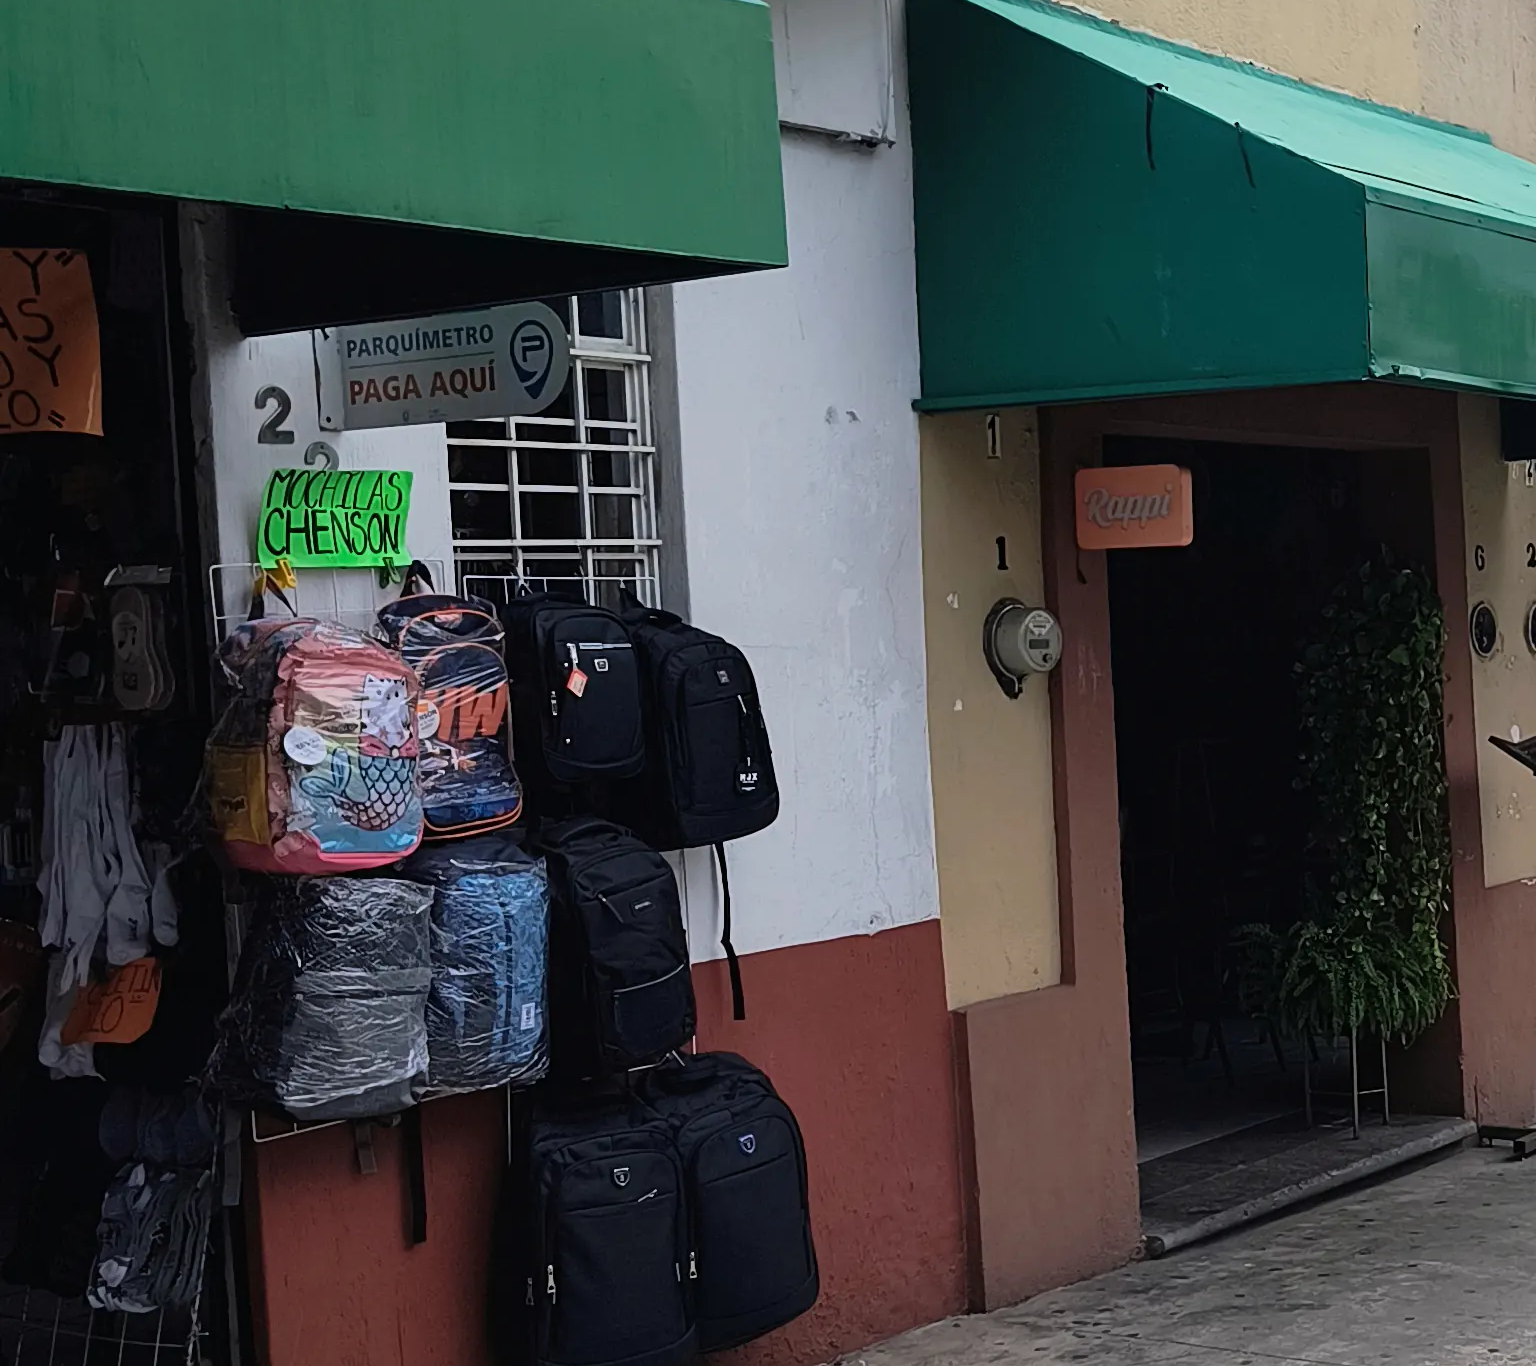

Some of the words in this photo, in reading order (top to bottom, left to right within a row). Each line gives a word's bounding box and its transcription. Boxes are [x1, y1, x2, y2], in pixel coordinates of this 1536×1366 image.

[346, 323, 494, 358] PARQUÍMETRO
[350, 373, 422, 405] PAGA
[429, 359, 496, 399] AQUÍ
[254, 386, 295, 444] 2
[987, 414, 996, 455] 1
[266, 469, 402, 511] MOCHILAS
[1083, 483, 1173, 530] Rappi
[263, 507, 401, 556] CHENSON
[995, 536, 1009, 570] 1
